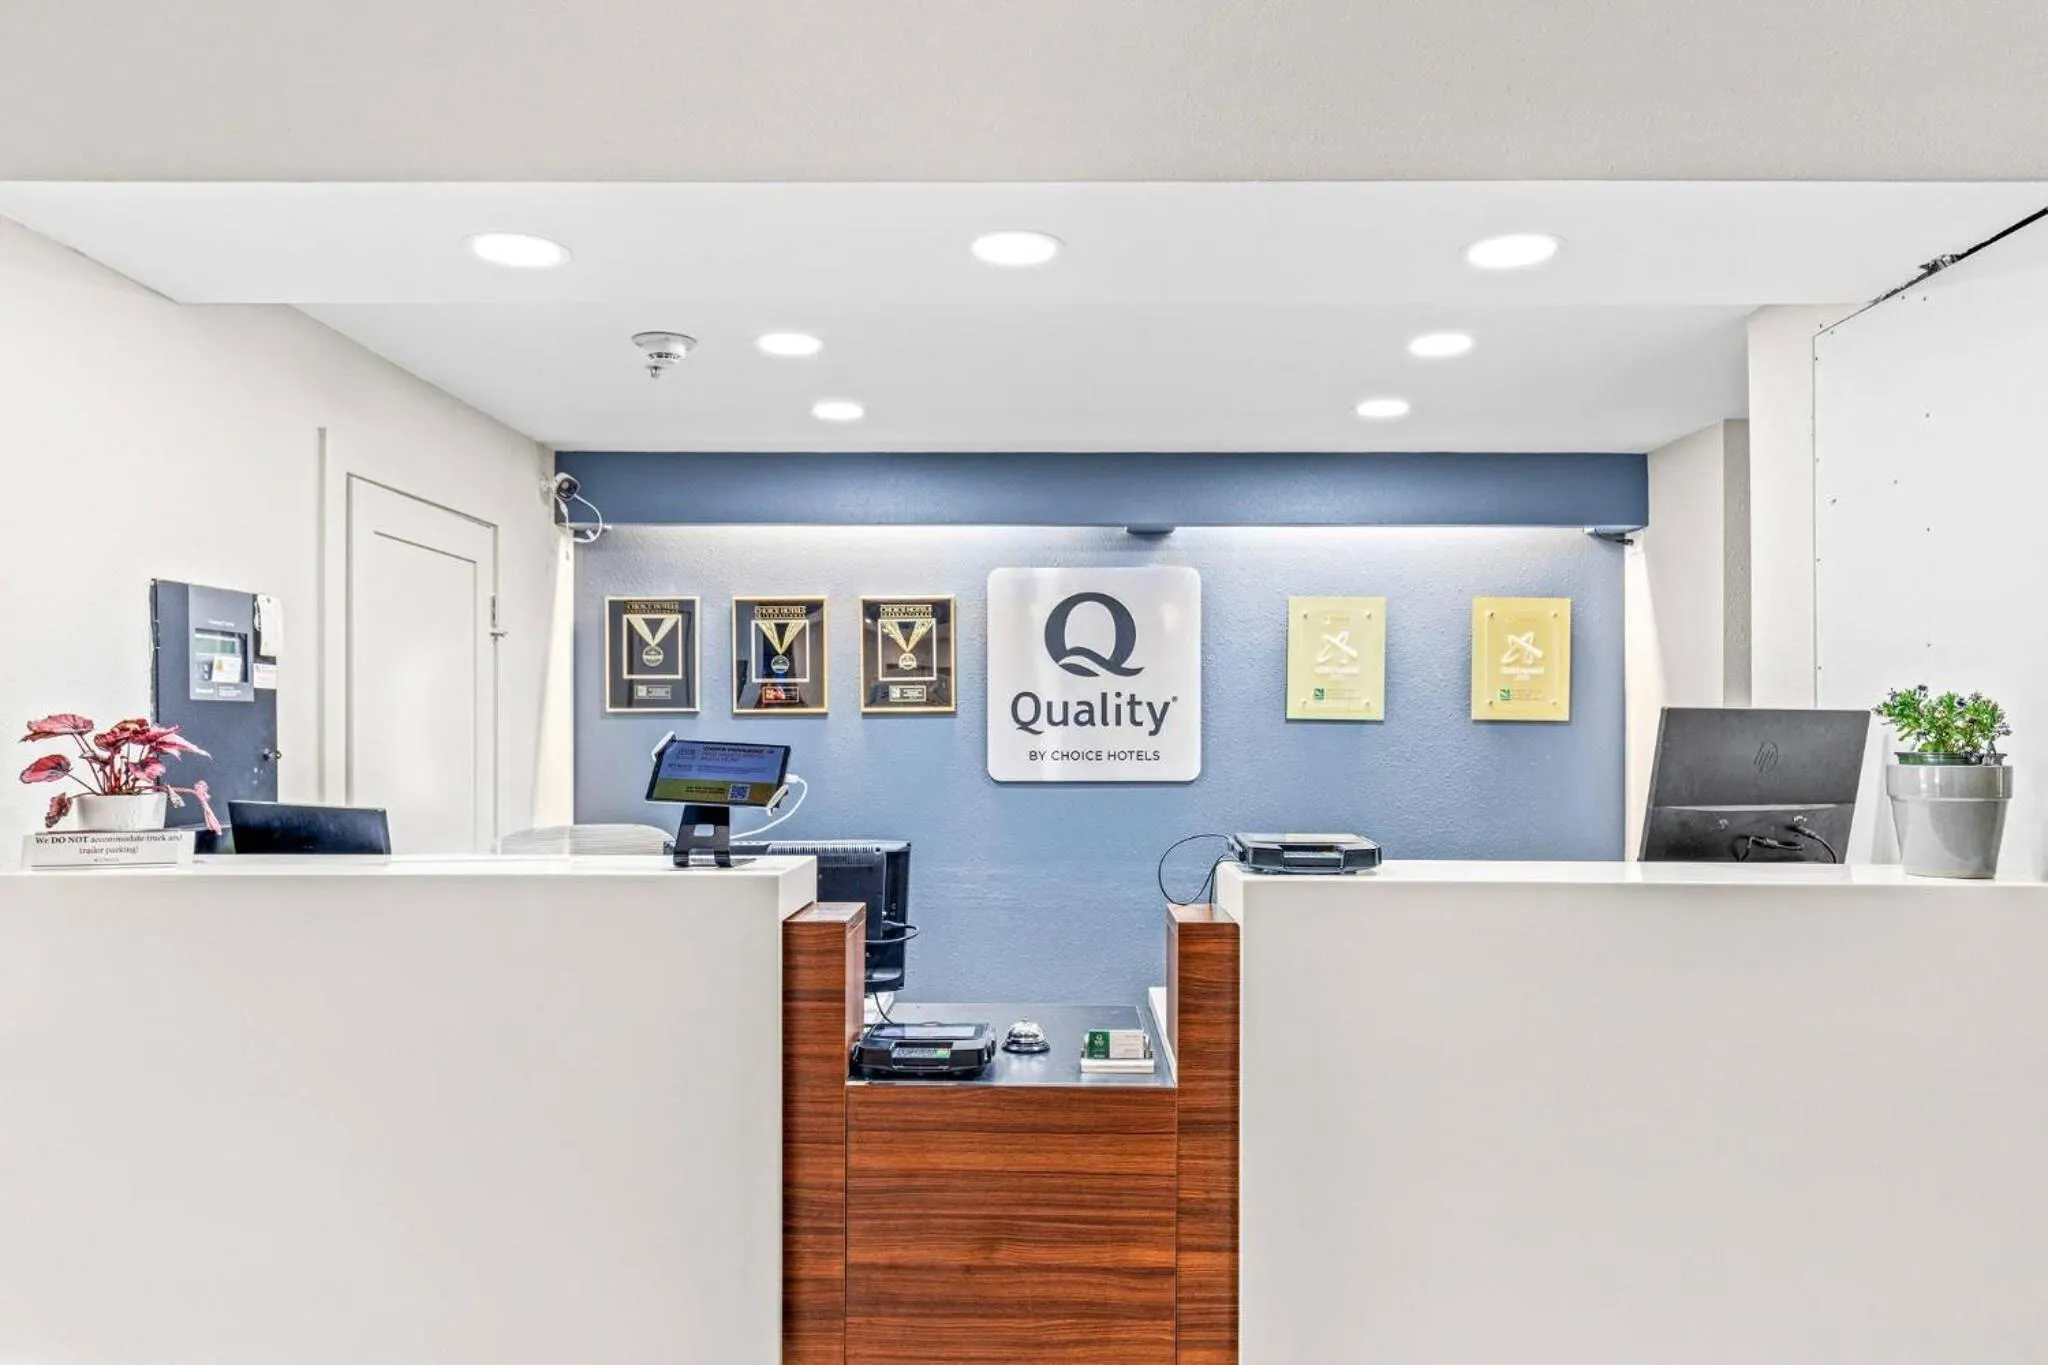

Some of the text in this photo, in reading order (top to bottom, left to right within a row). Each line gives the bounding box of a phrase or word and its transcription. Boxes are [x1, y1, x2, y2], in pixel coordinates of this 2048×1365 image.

[1044, 592, 1145, 677] Q
[1011, 691, 1172, 737] Quality
[1029, 750, 1160, 761] BY CHOICE HOTELS
[35, 836, 48, 844] We
[51, 836, 66, 844] DO
[68, 836, 89, 844] NOT
[147, 833, 166, 842] truck
